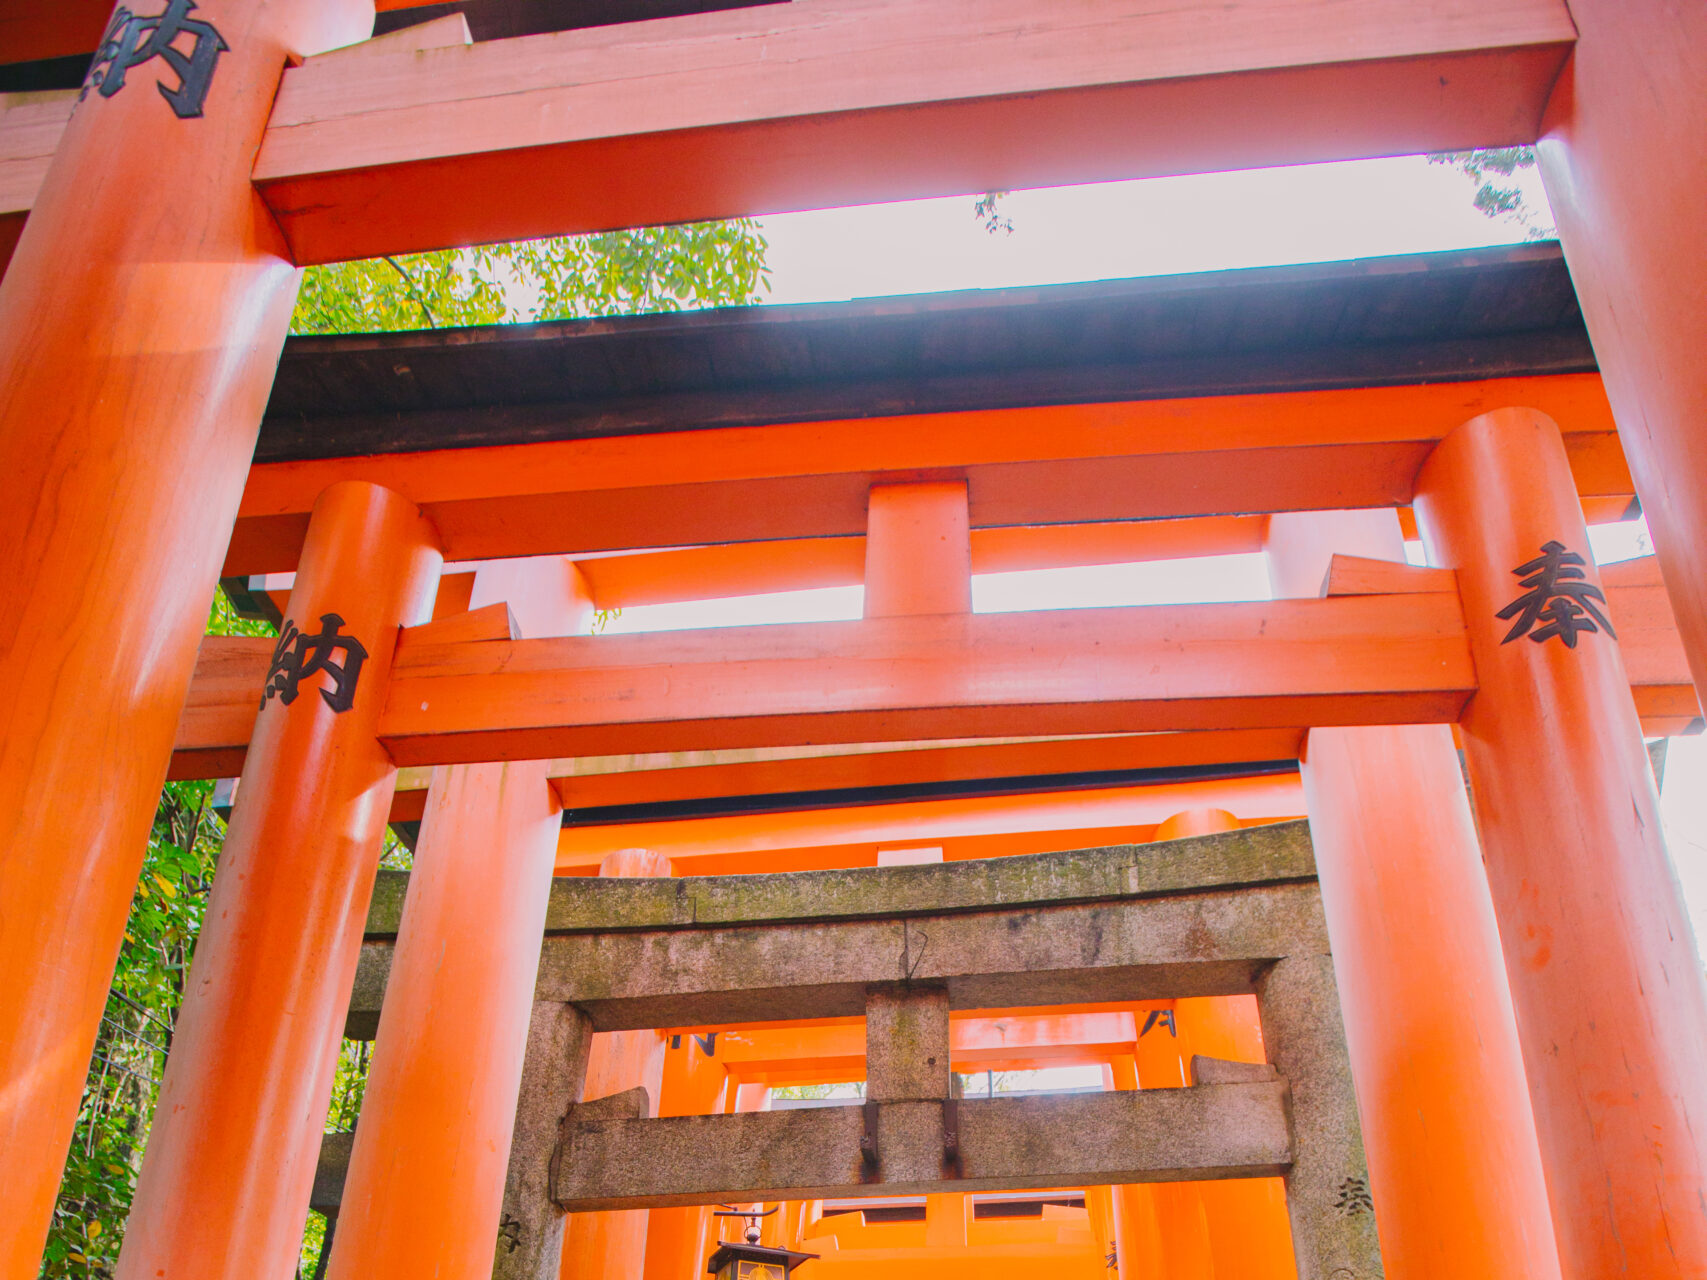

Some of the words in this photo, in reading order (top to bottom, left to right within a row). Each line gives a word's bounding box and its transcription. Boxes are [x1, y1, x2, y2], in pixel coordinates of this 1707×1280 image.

[76, 0, 231, 118] 納
[1494, 540, 1618, 650] 奉
[259, 613, 369, 714] 納
